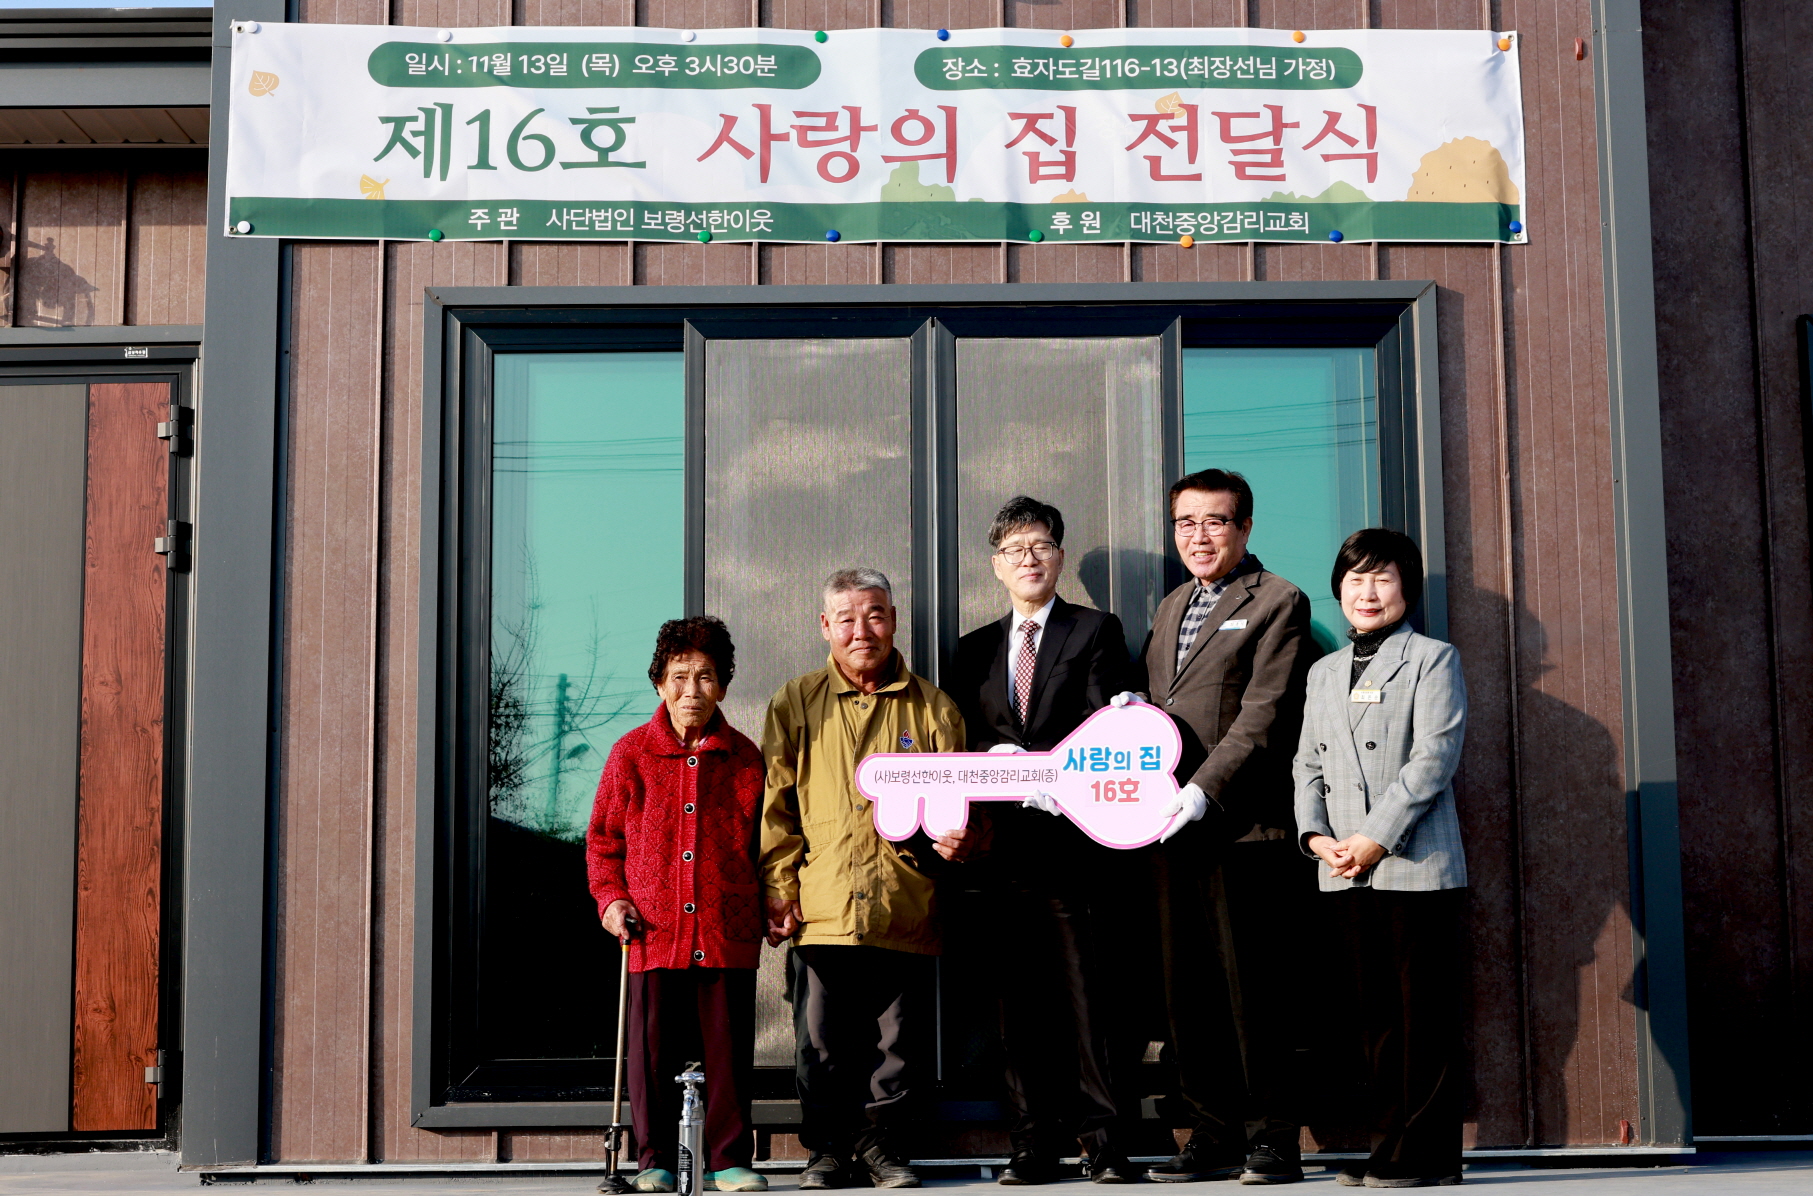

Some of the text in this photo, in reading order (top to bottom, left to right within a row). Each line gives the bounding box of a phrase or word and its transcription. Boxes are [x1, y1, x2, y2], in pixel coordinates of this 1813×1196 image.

[468, 53, 511, 75] 11월
[519, 53, 567, 75] 13일
[582, 54, 619, 77] (목)
[633, 54, 678, 76] 오후
[685, 55, 777, 76] 3시30분
[1012, 56, 1276, 80] 효자도길116-13(최장선님
[1284, 58, 1335, 80] 가정)
[374, 102, 1378, 184] 제16호 사랑의 집 전달식
[546, 208, 633, 231] 사단법인
[642, 210, 774, 234] 보령선한이웃
[1131, 211, 1309, 236] 대천중앙감리교회
[1063, 745, 1162, 772] 사랑의 집
[874, 768, 1058, 785] (사)보령선한이웃, 대천중앙감리교회(증)
[1091, 778, 1140, 803] 16호
